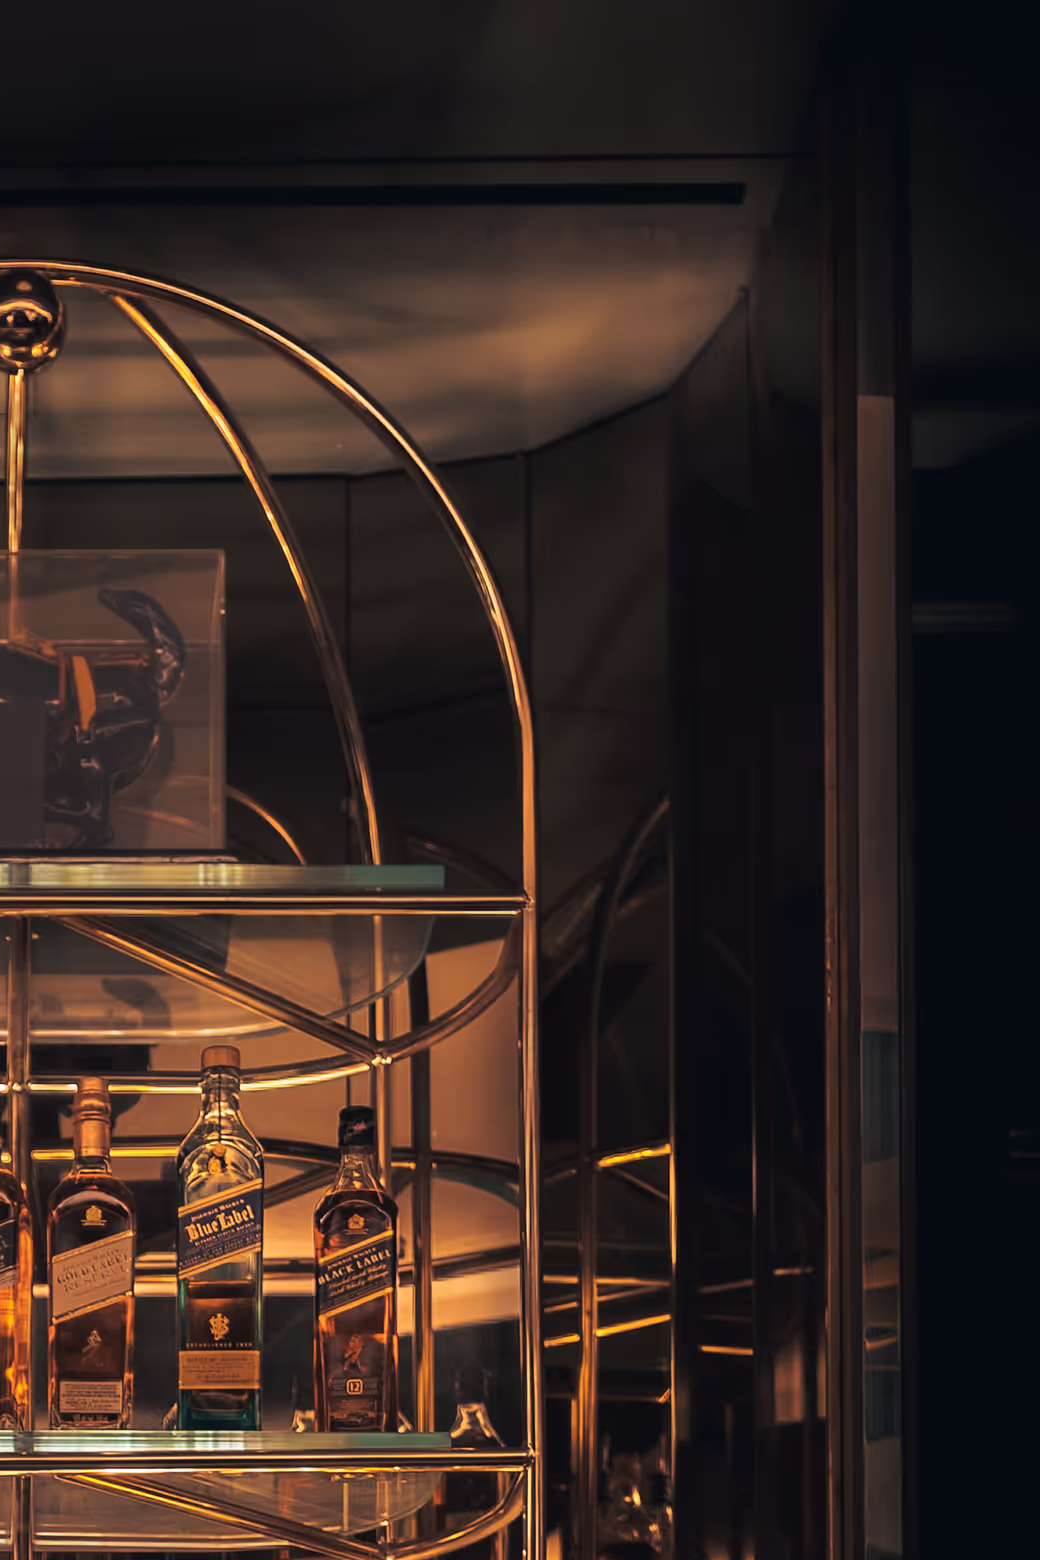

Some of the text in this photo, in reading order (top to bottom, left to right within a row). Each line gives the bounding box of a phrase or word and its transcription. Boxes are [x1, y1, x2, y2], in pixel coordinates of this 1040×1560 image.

[185, 1204, 255, 1243] Blue Label
[318, 1264, 355, 1285] BLACK
[356, 1249, 391, 1269] LABEL
